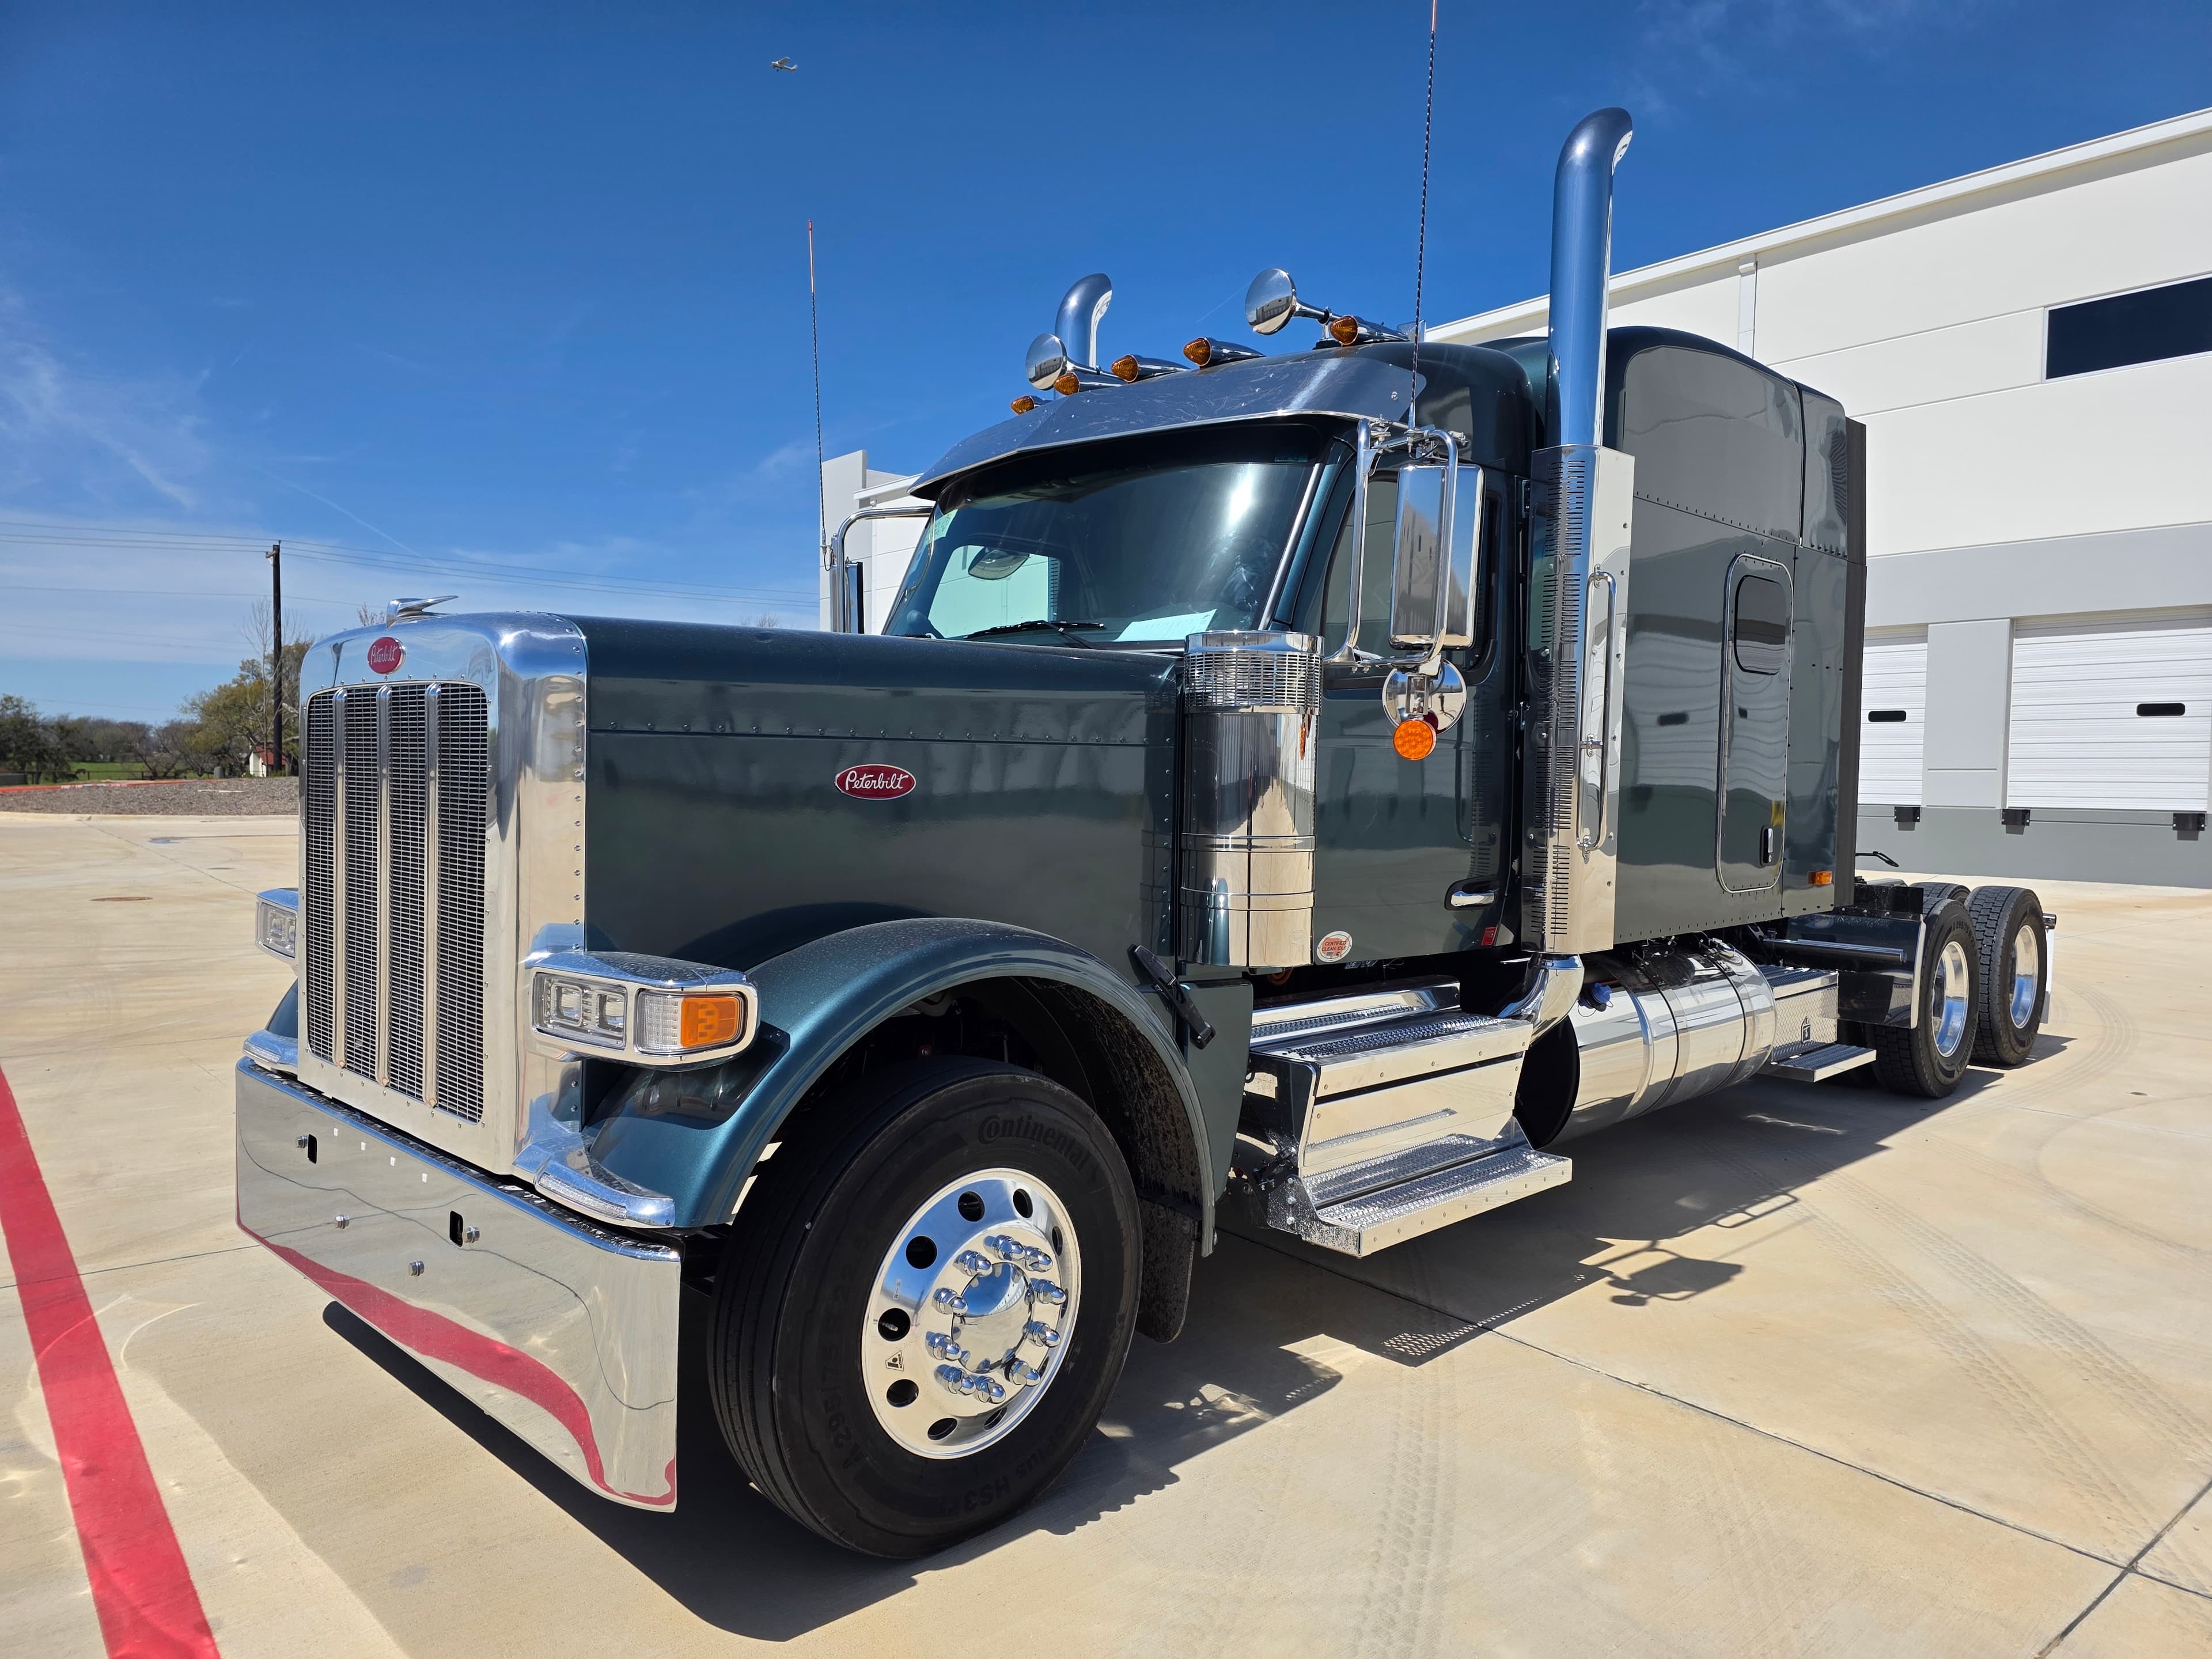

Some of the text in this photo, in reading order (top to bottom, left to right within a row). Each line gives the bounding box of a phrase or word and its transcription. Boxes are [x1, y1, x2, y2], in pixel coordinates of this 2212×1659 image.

[370, 645, 398, 665] Peterbilt
[845, 770, 909, 791] Peterbilt
[978, 1115, 1092, 1173] Continental
